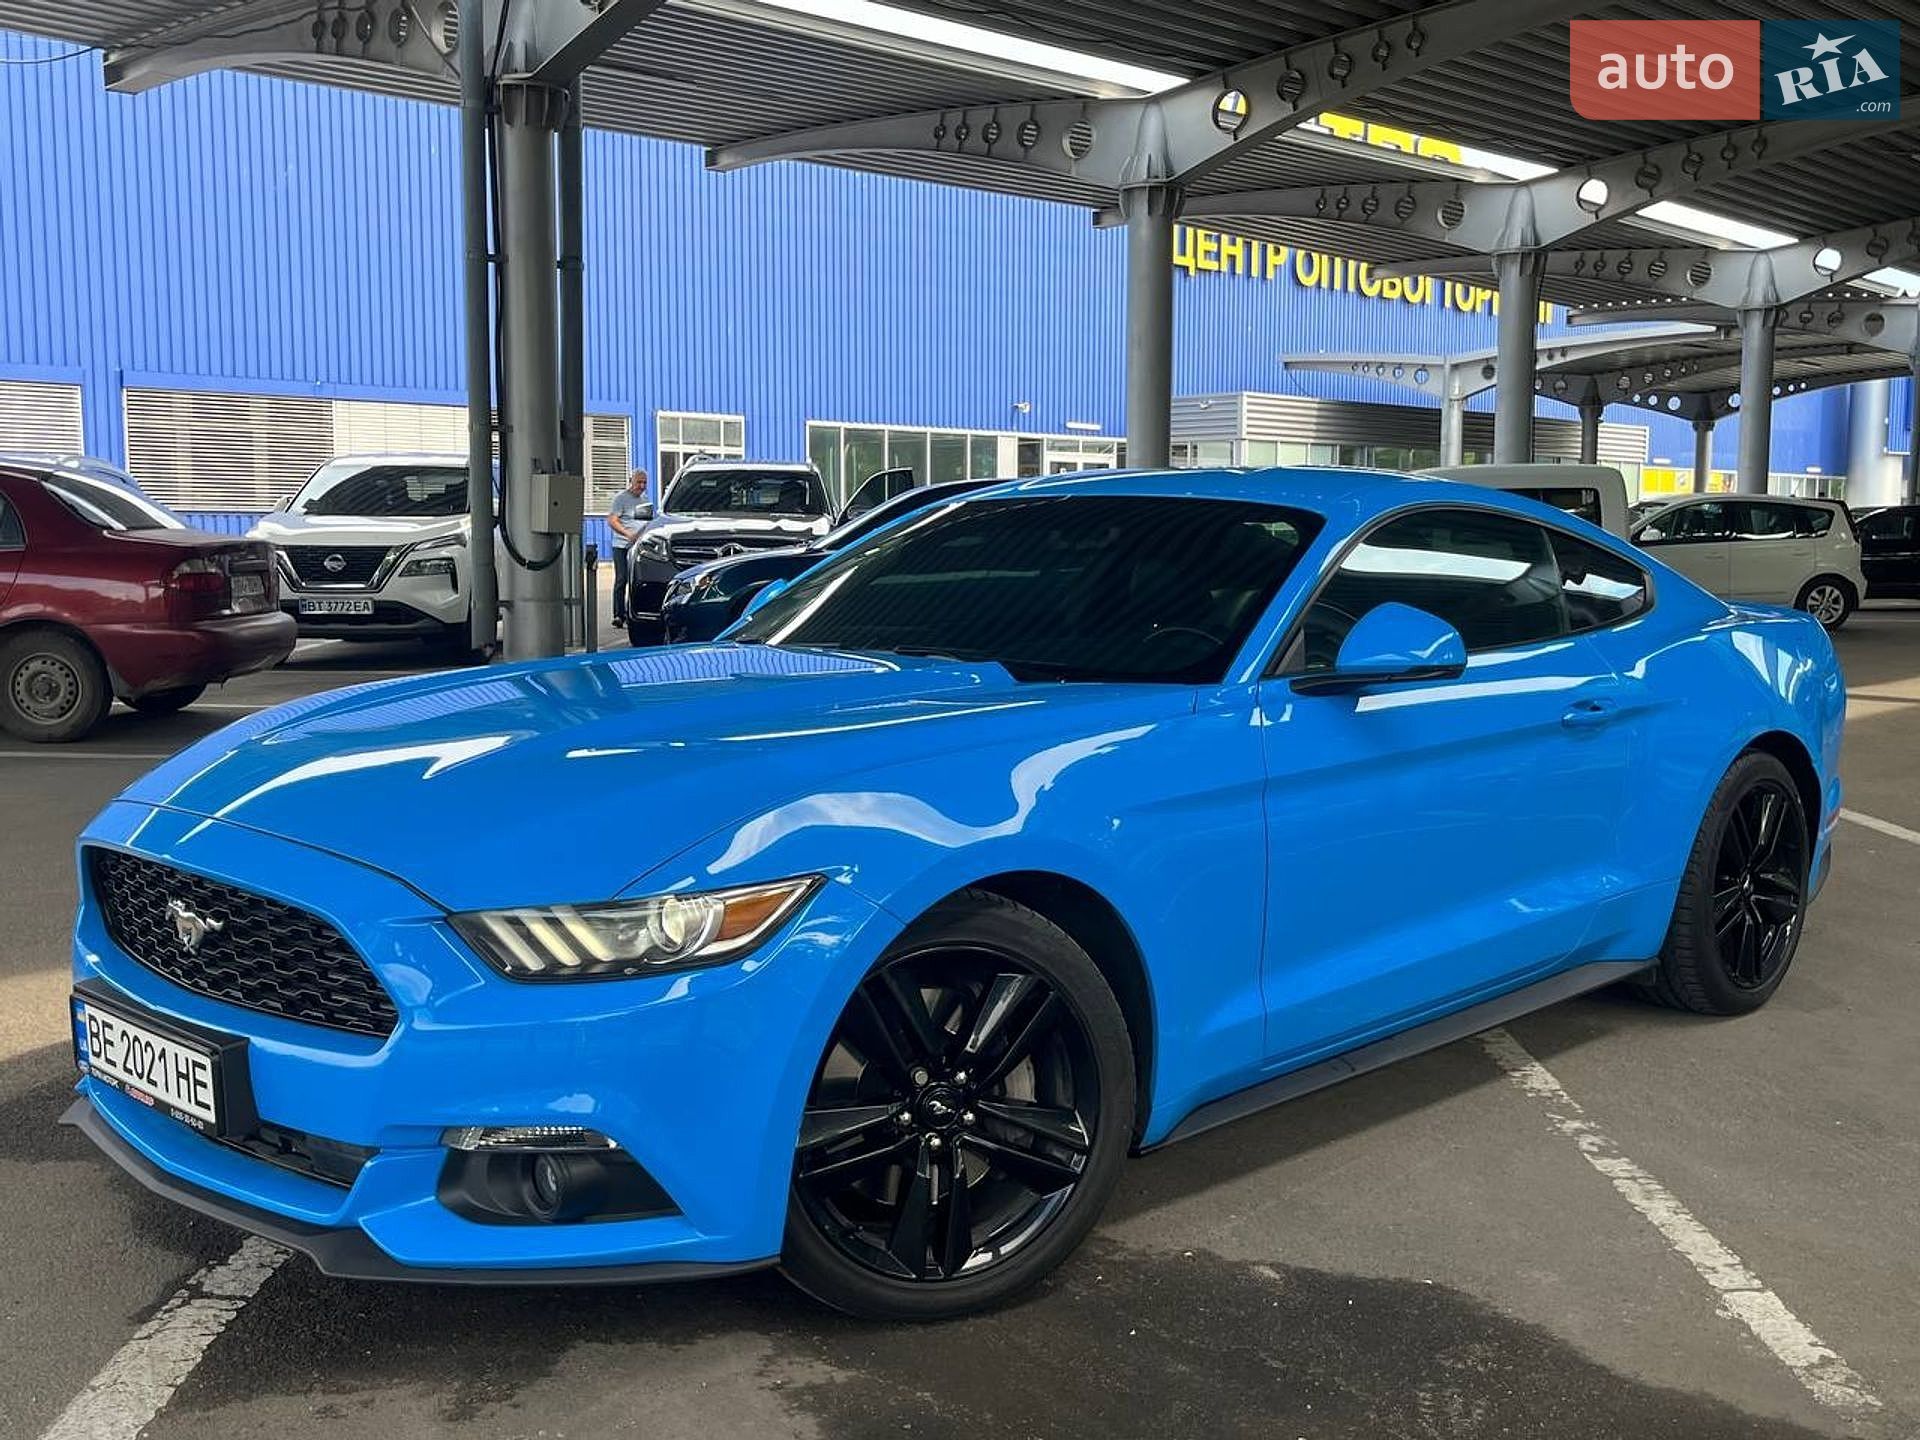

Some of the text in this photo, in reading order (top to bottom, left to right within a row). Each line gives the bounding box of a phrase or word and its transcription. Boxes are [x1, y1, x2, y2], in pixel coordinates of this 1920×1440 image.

[88, 1013, 212, 1112] BE 2021 HE
